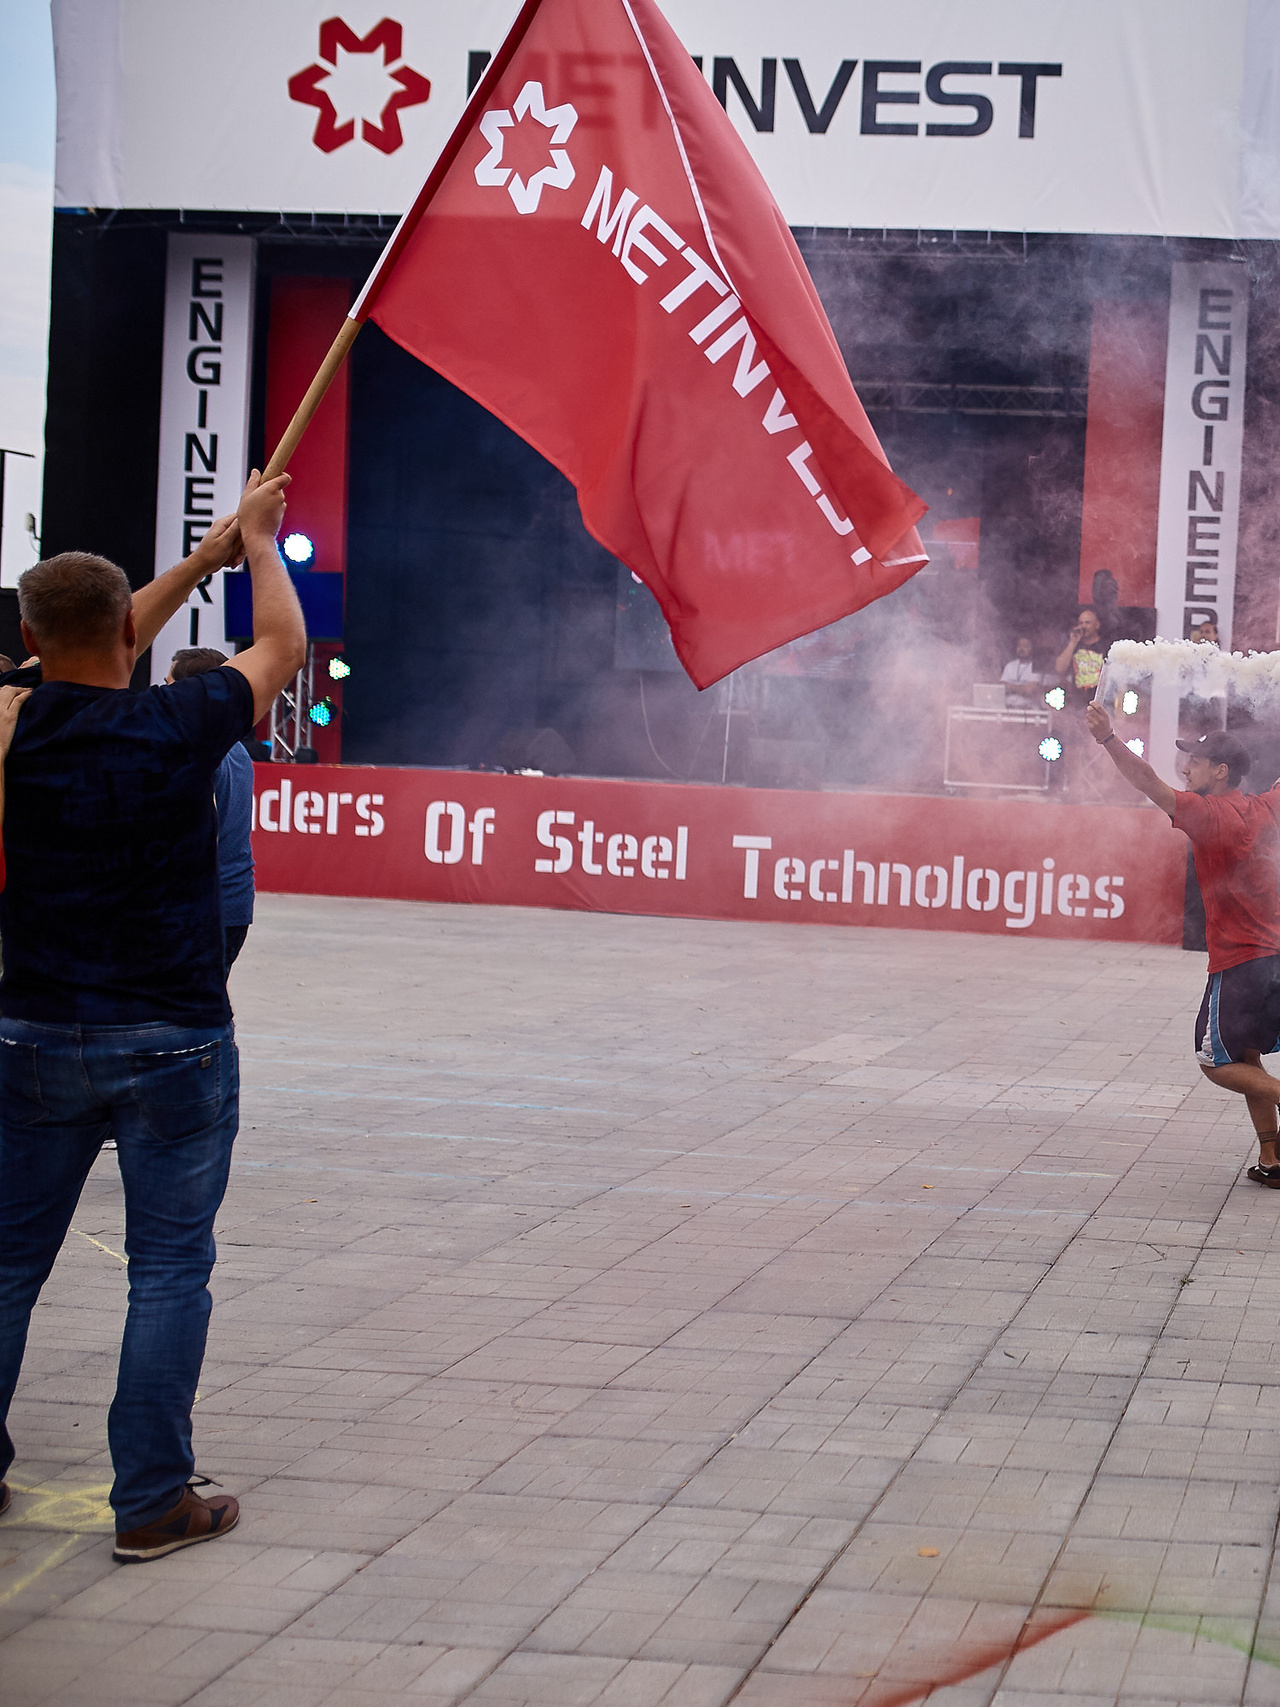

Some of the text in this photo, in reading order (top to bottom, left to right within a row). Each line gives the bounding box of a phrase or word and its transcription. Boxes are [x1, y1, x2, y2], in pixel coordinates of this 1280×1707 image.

[466, 50, 1064, 139] METNVEST
[580, 164, 873, 566] METINV
[425, 801, 496, 865] Of
[535, 810, 689, 880] Steel
[733, 835, 1125, 928] Technologies
